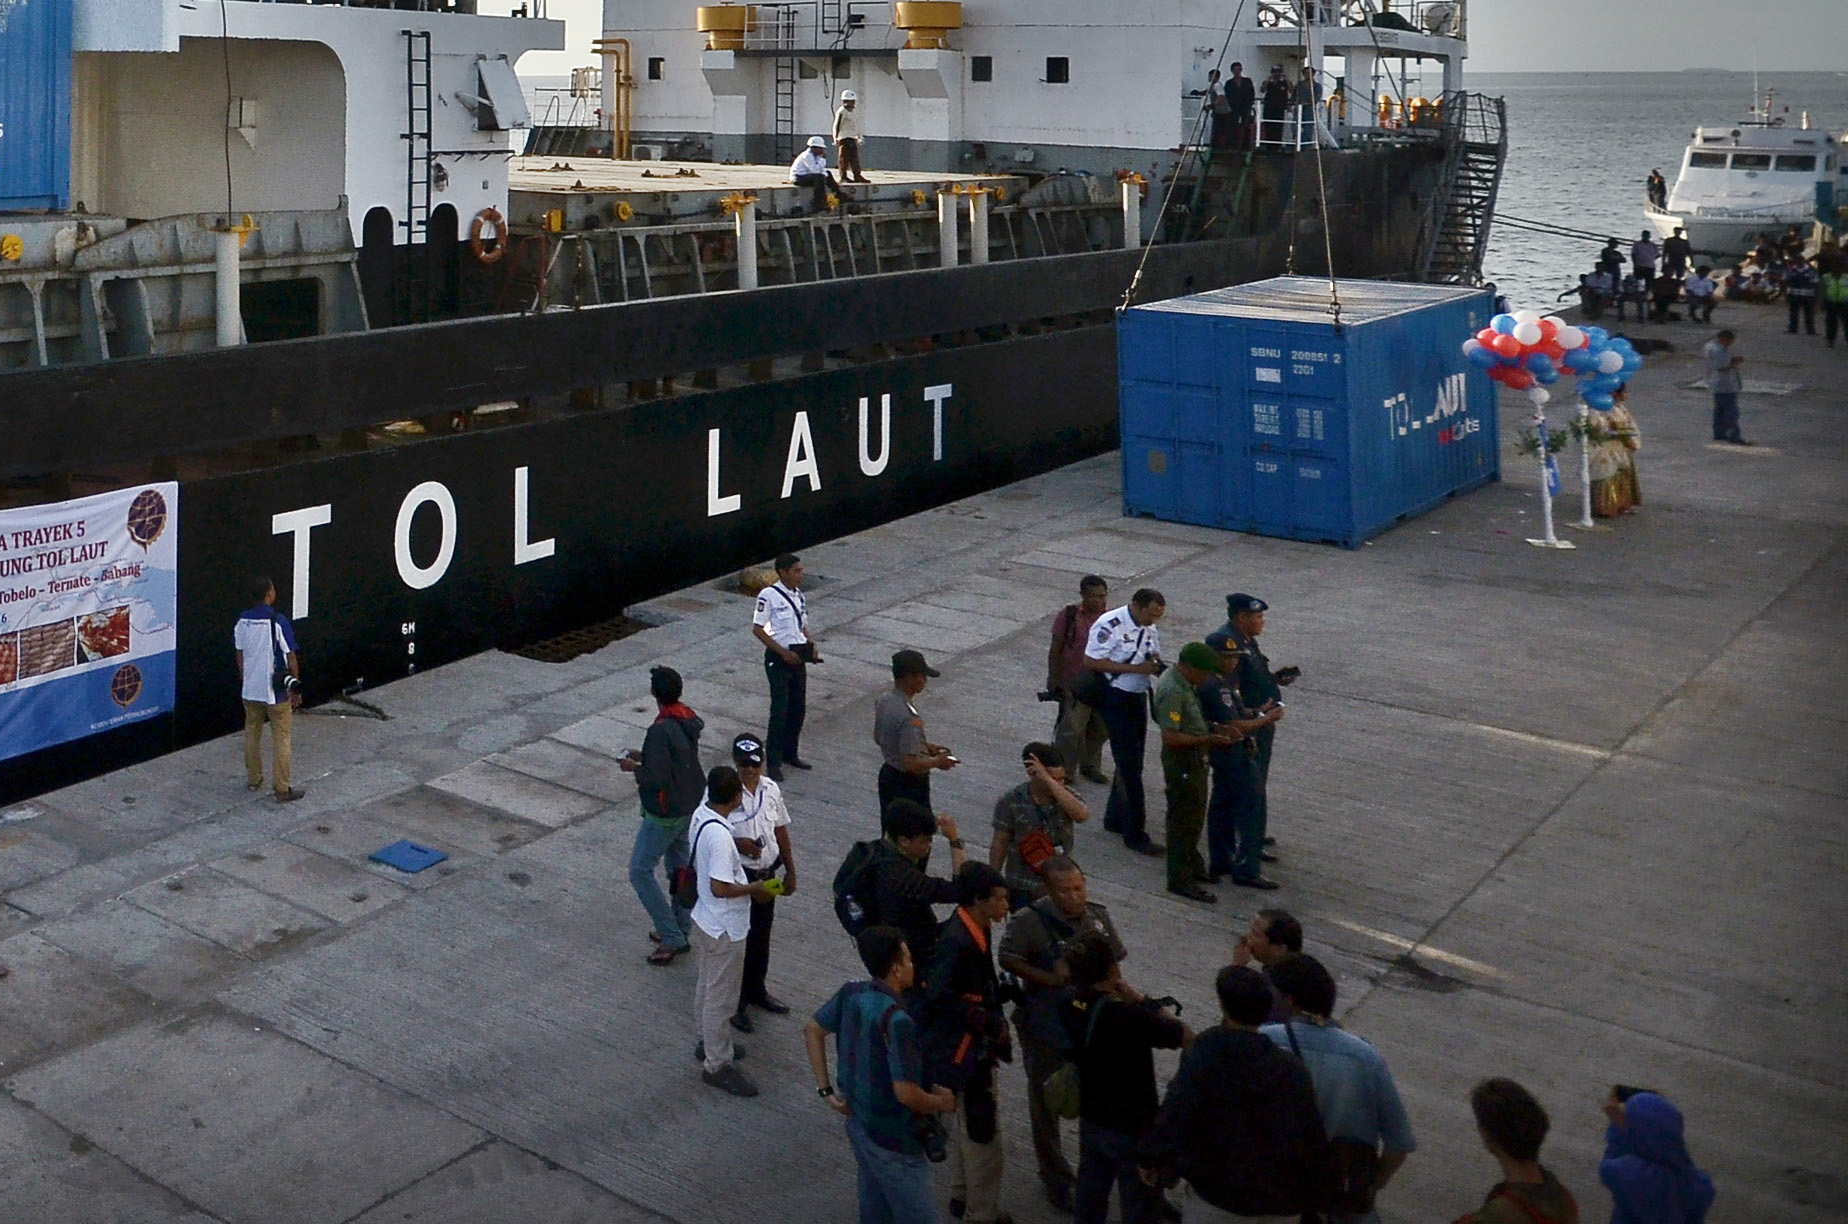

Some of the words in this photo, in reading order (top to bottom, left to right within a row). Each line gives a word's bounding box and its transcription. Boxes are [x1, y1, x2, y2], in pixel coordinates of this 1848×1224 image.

[1251, 346, 1281, 358] SBNU
[271, 465, 556, 620] TOL
[706, 383, 953, 518] LAUT
[11, 522, 73, 549] TRAYEK
[76, 519, 86, 537] 5
[36, 550, 66, 570] TOL
[69, 540, 109, 564] LAUT
[47, 573, 92, 594] Ternate
[408, 642, 415, 655] 8
